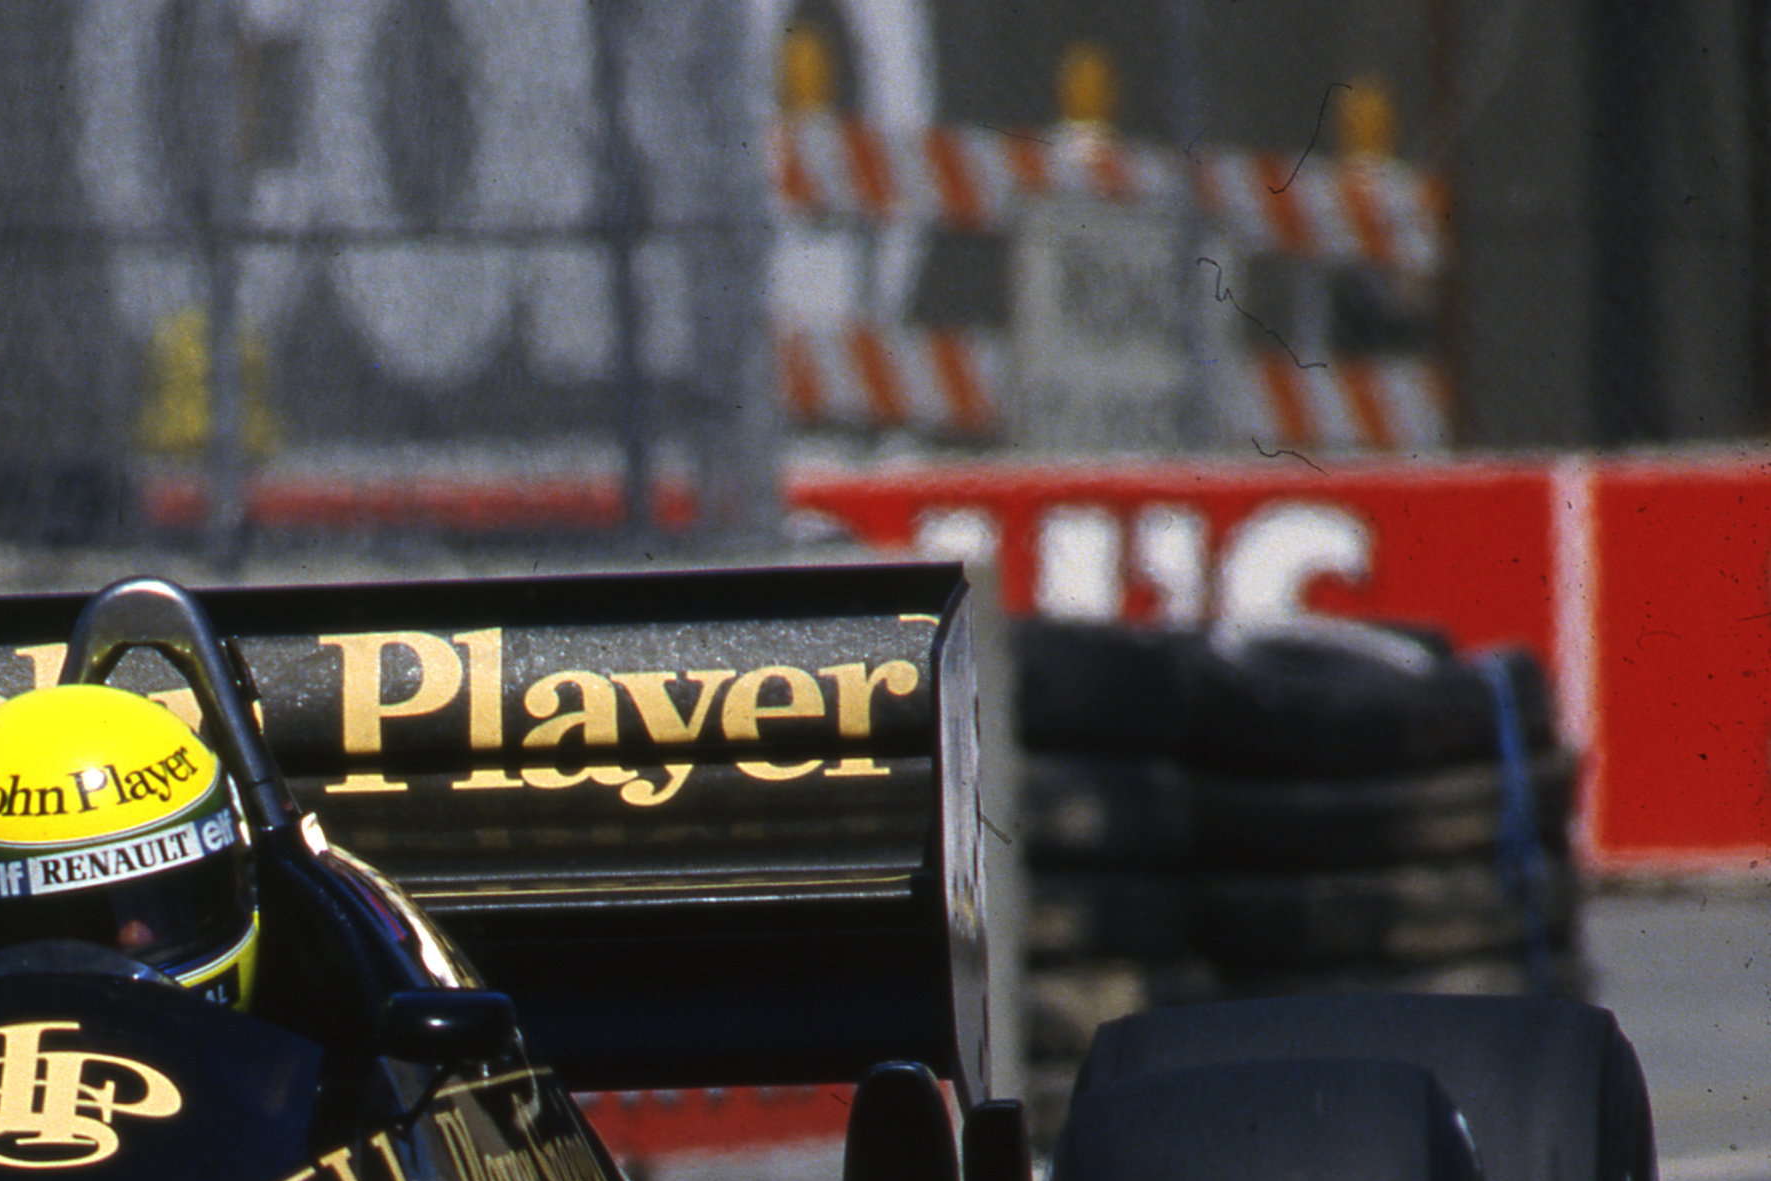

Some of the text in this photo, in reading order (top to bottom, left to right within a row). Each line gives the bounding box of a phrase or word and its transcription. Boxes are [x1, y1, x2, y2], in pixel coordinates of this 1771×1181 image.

[318, 627, 920, 806] Player
[66, 746, 199, 814] Player
[41, 831, 192, 886] RENAULT
[201, 809, 235, 851] elf
